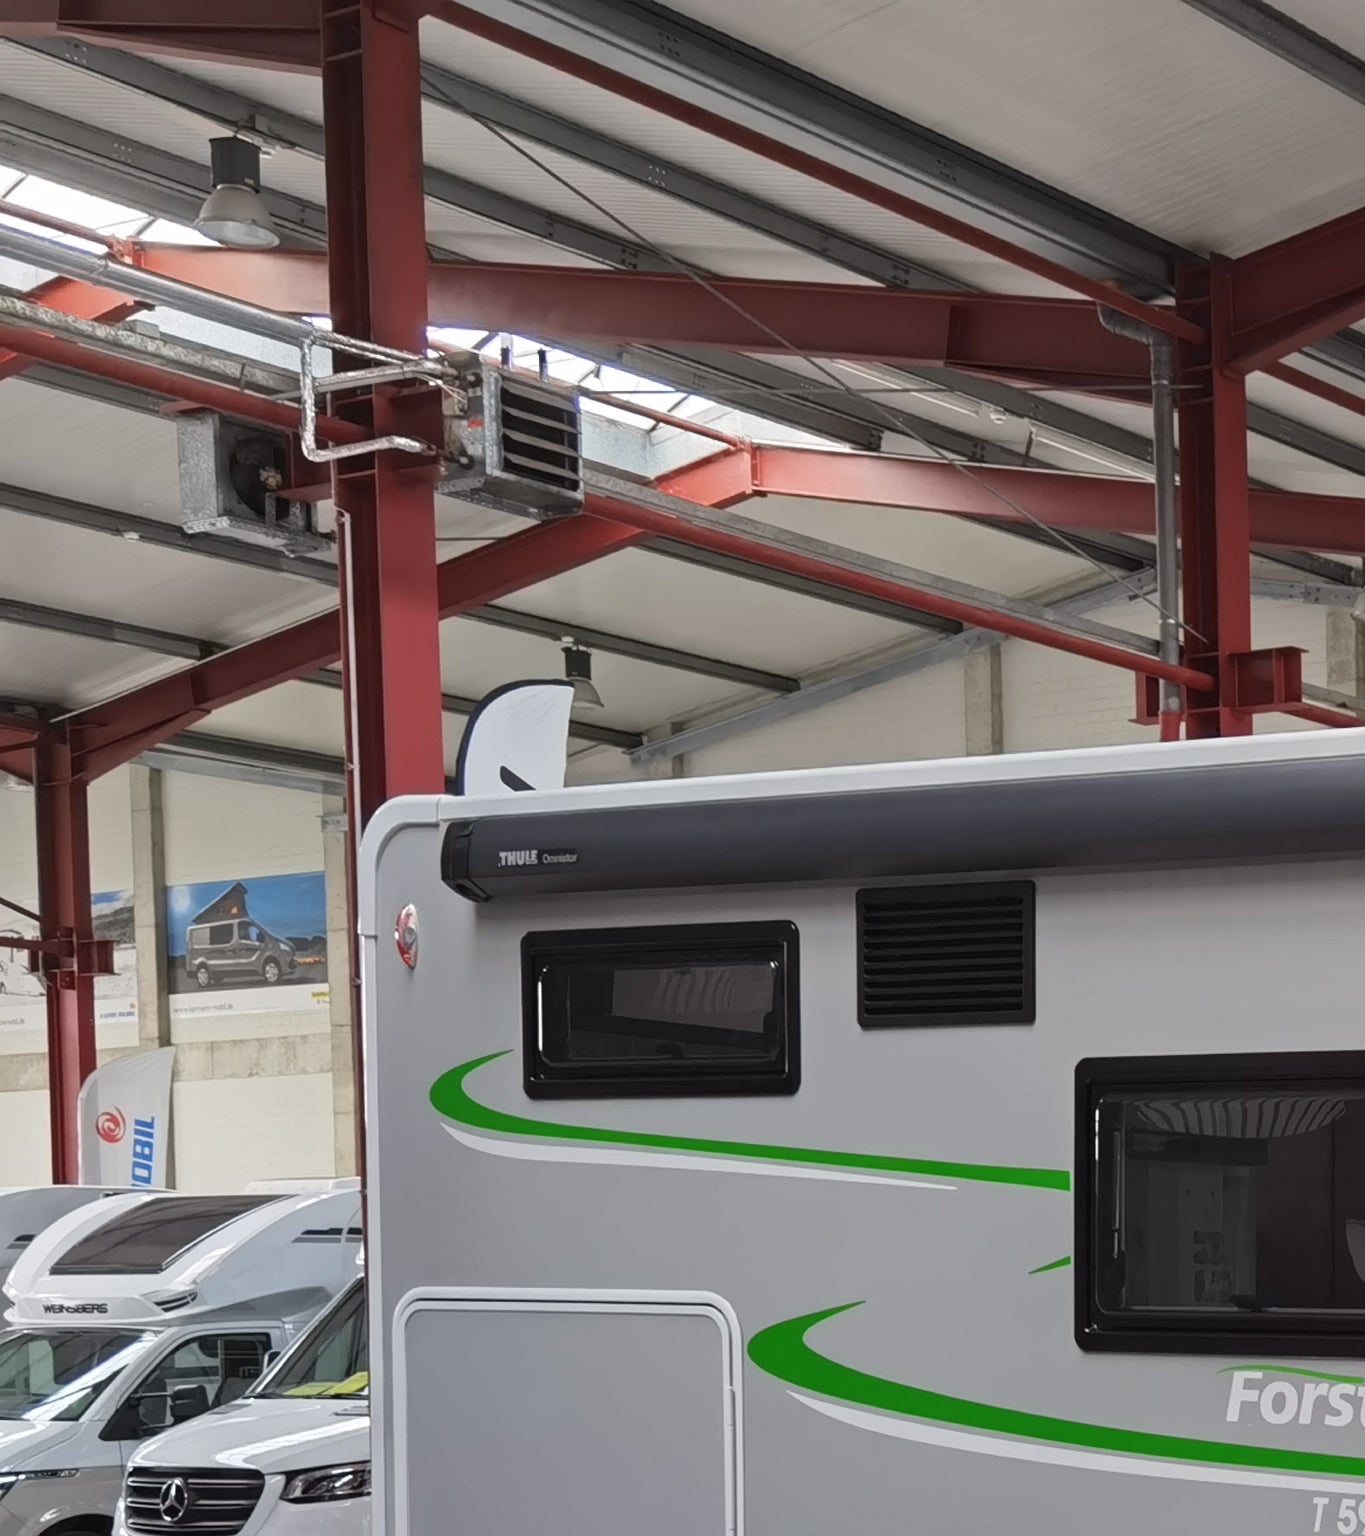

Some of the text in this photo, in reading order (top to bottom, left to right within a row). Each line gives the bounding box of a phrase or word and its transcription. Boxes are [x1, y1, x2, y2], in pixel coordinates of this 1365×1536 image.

[499, 849, 539, 867] THULE
[130, 1115, 155, 1187] OBIL
[1312, 1497, 1330, 1533] T
